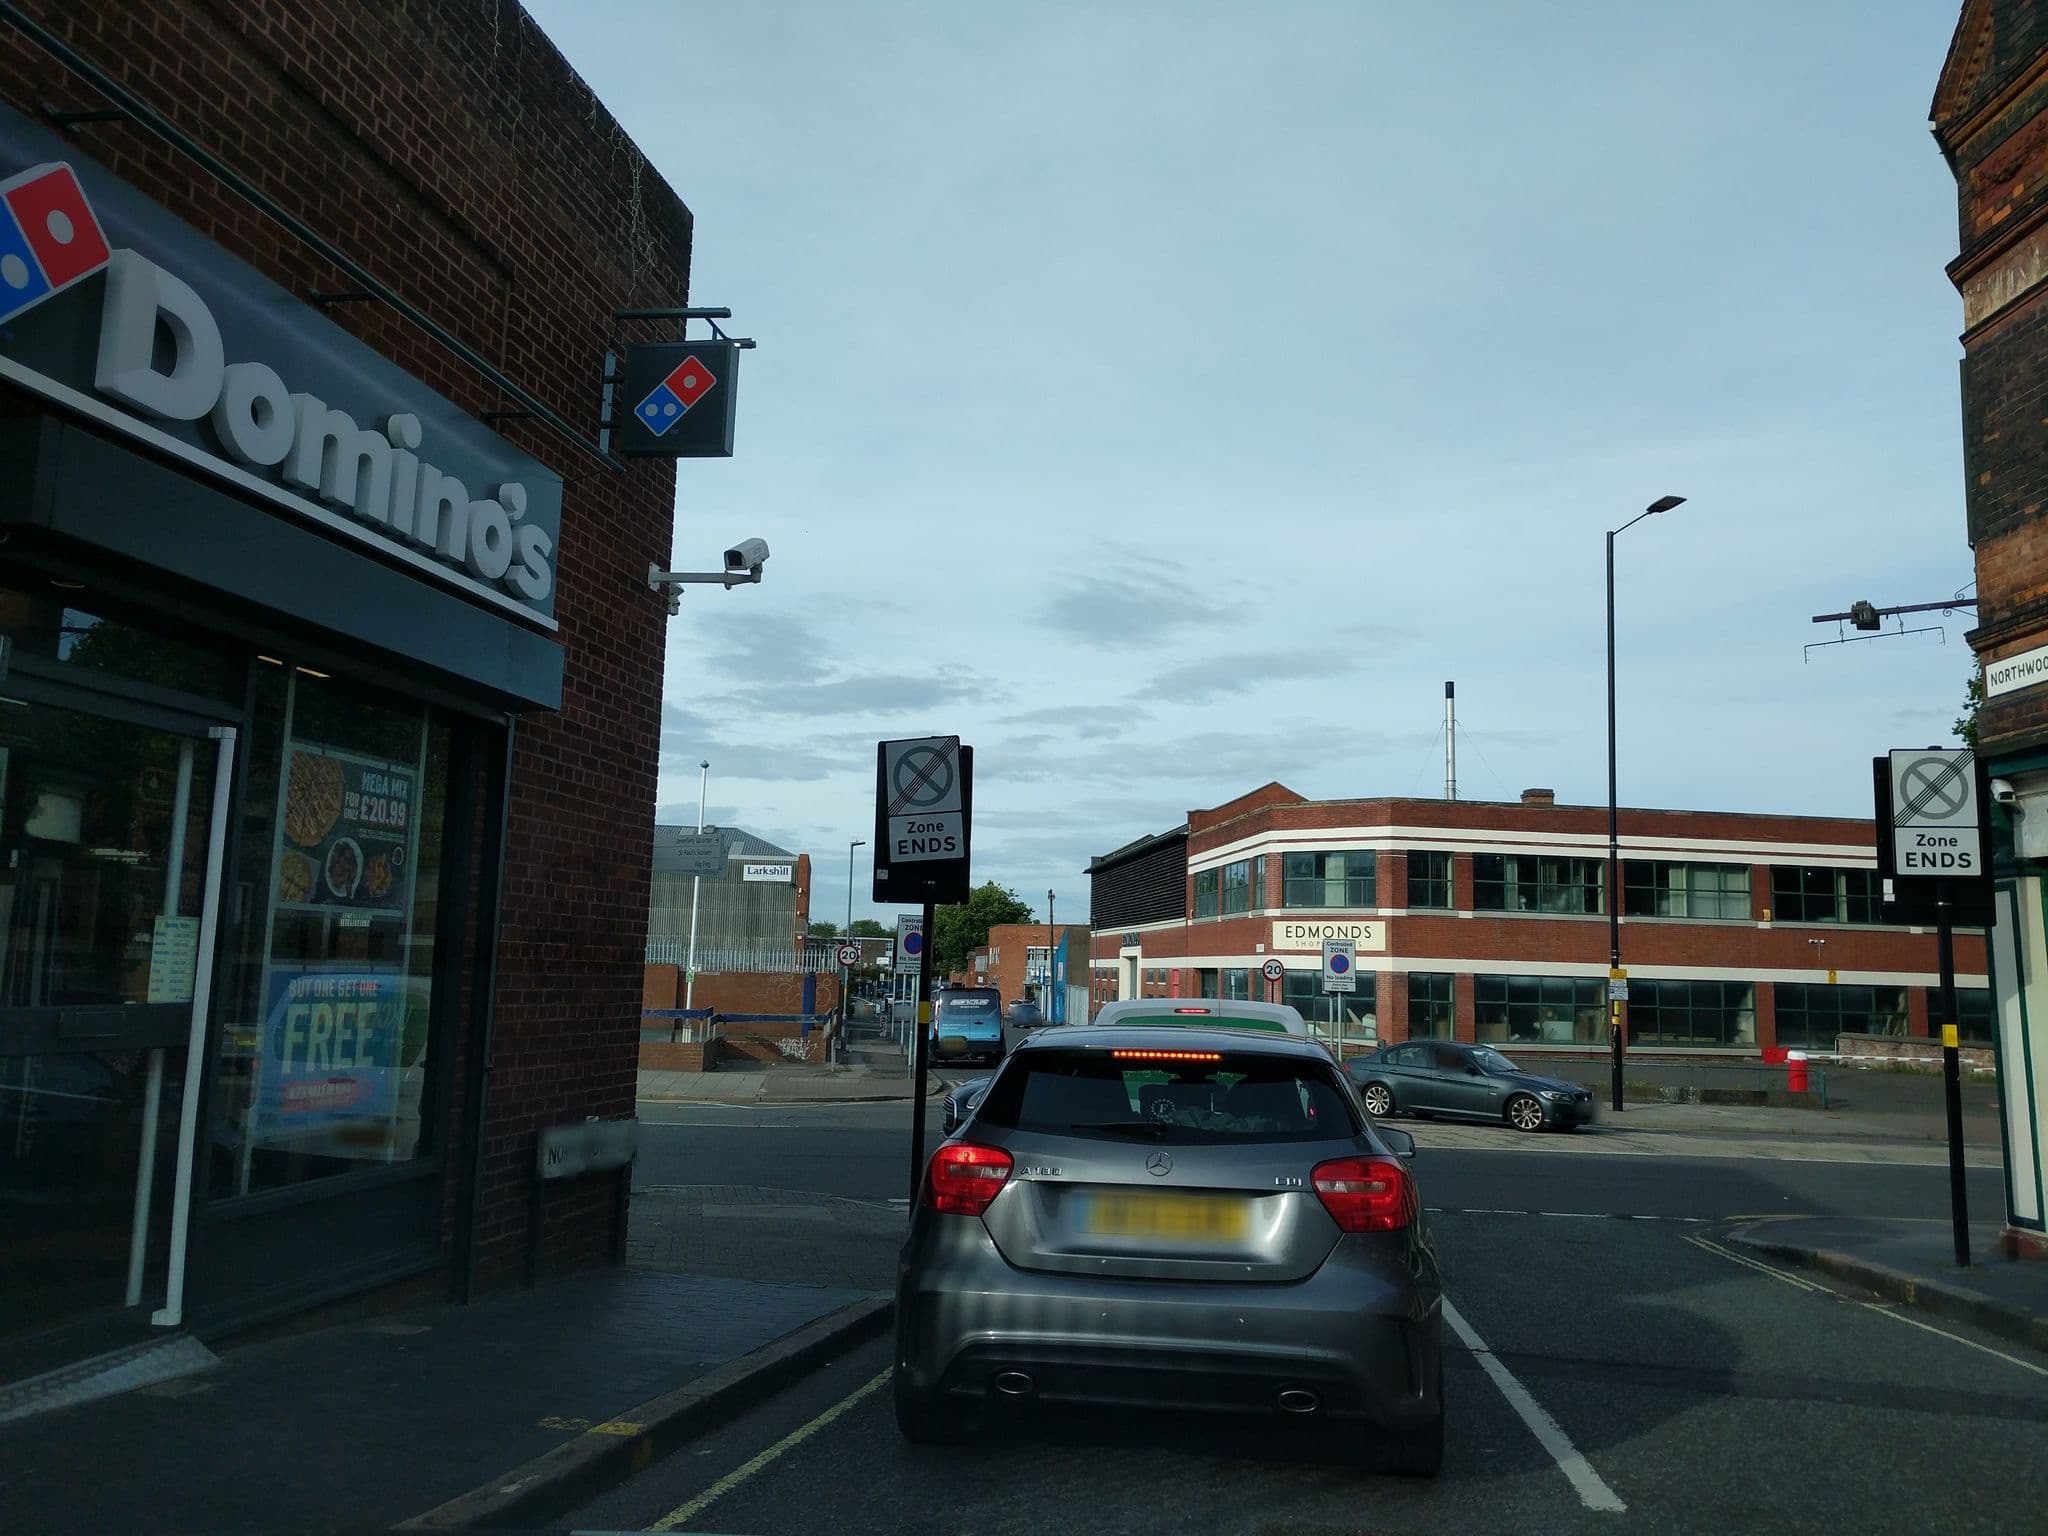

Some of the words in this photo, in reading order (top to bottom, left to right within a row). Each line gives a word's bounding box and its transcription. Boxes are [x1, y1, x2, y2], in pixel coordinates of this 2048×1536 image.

[94, 247, 555, 602] Domino's
[361, 770, 388, 795] MEGA
[391, 776, 408, 800] MIX
[345, 791, 360, 808] FOR
[361, 795, 406, 827] £20.99
[907, 820, 946, 834] Zone
[898, 835, 957, 856] ENDS
[1916, 833, 1958, 847] Zone
[1905, 851, 1972, 869] ENDS
[747, 866, 789, 876] Larkshill
[1285, 926, 1372, 939] EDMONDS
[842, 950, 857, 960] 20
[1266, 965, 1282, 975] 20
[288, 978, 313, 999] BUY
[313, 979, 335, 998] ONE
[337, 979, 358, 999] GET
[282, 1002, 378, 1075] FREE
